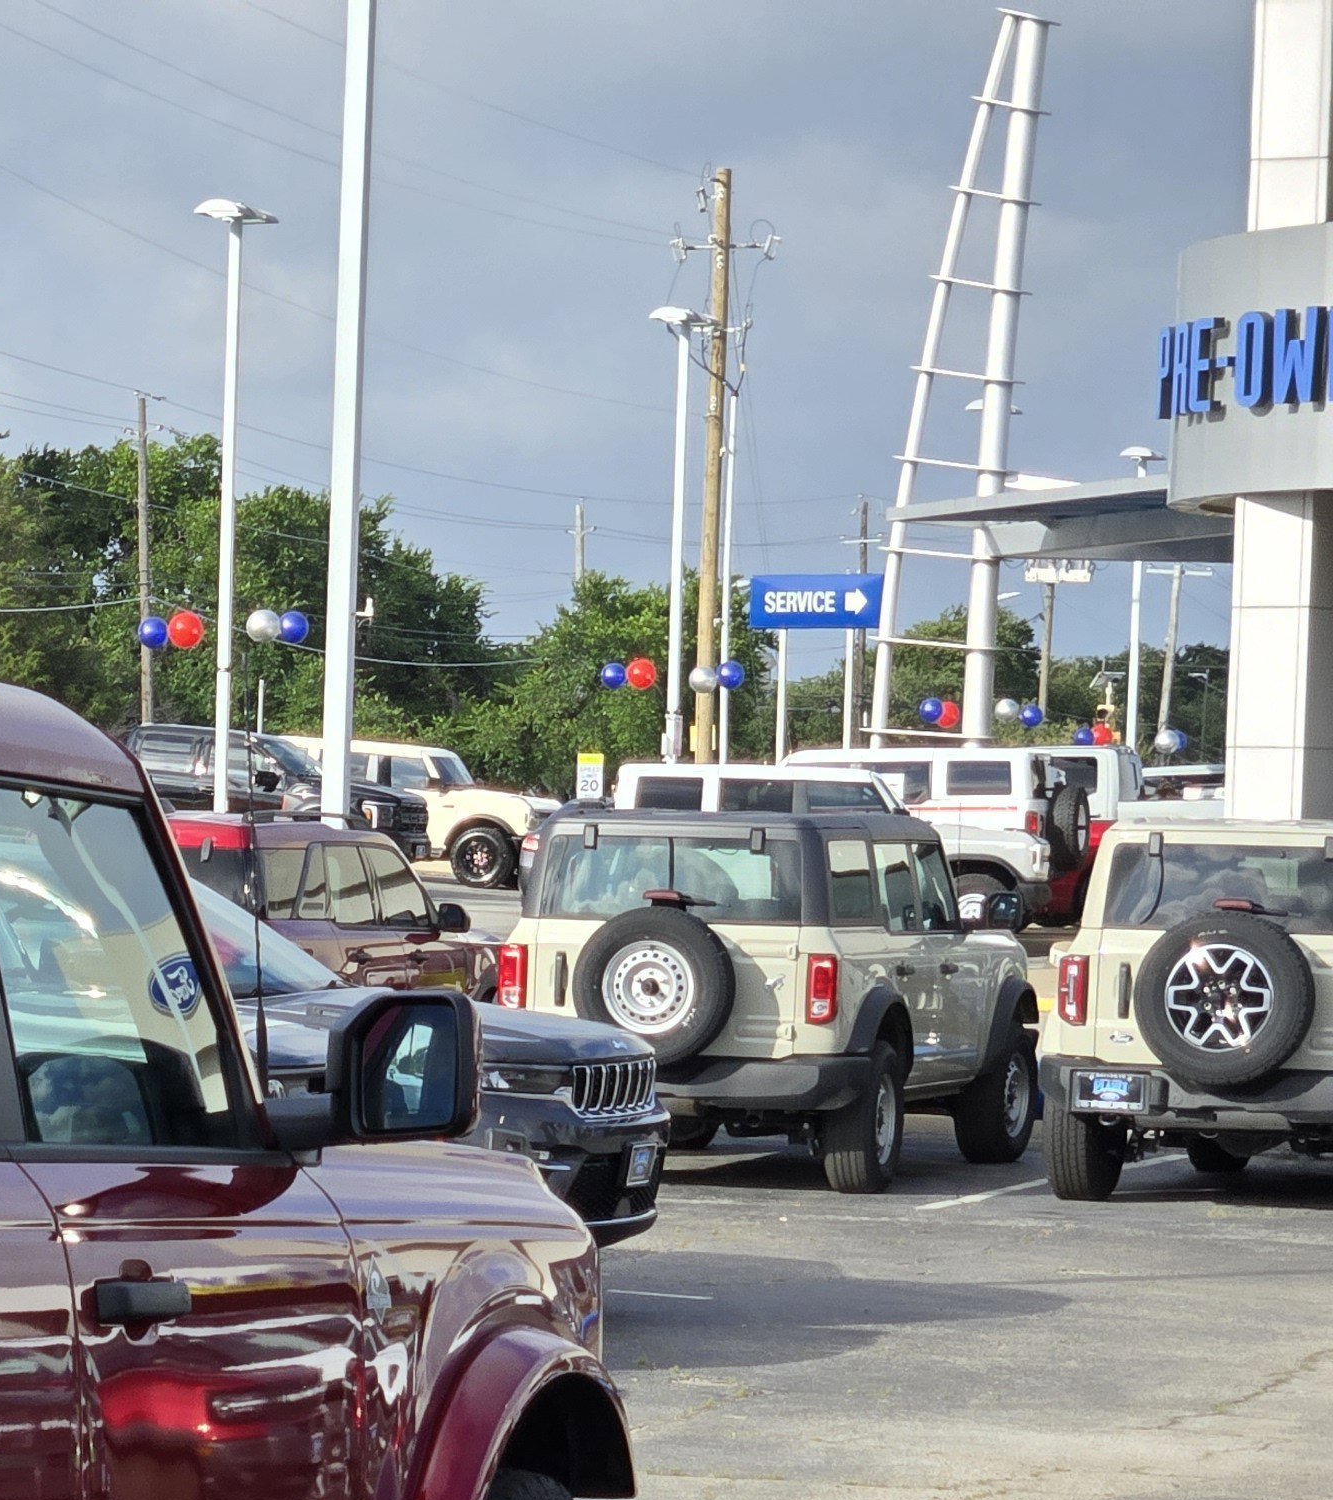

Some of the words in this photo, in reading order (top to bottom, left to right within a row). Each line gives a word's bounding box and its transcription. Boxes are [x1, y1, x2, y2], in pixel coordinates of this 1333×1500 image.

[1157, 306, 1333, 420] PRE-OW
[764, 590, 836, 613] SERVICE
[580, 779, 599, 791] 20
